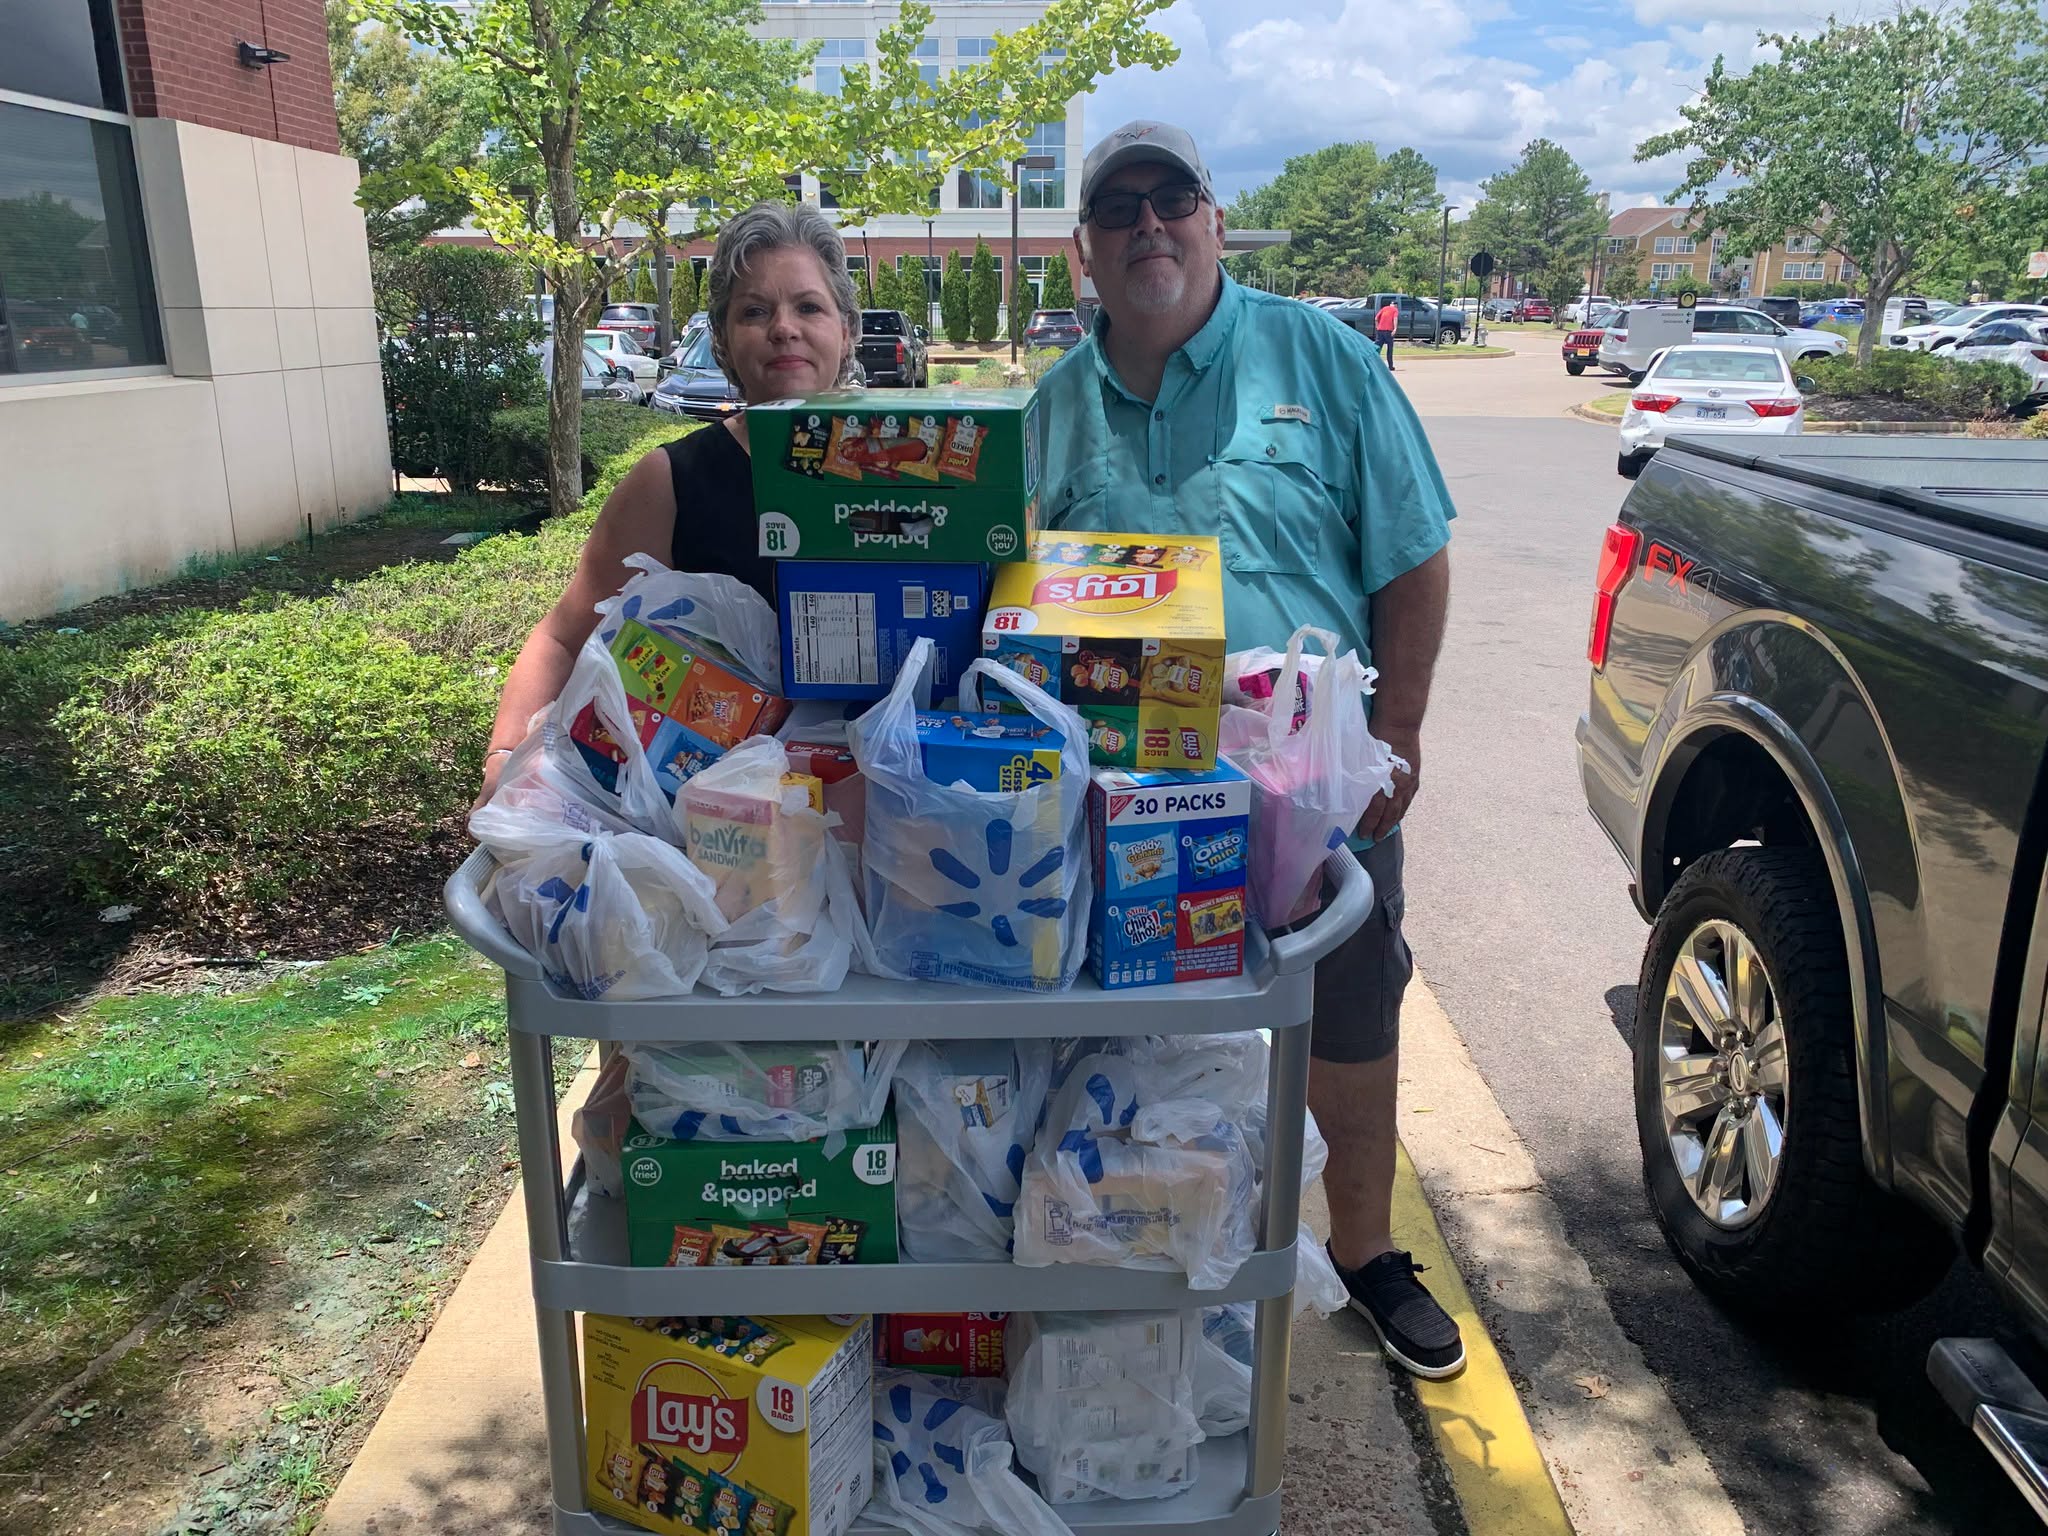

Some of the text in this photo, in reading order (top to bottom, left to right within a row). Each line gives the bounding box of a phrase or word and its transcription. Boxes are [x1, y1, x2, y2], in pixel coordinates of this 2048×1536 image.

[766, 530, 786, 551] 18
[991, 532, 1013, 542] fried
[994, 542, 1011, 551] not
[1643, 540, 1720, 613] FX4
[1048, 572, 1158, 604] Lay's
[994, 616, 1020, 631] 18
[986, 638, 997, 646] 3
[1144, 727, 1171, 749] 18
[1182, 732, 1201, 757] Lay's
[1144, 749, 1169, 757] BAGS
[1002, 768, 1012, 792] SIZE
[1014, 757, 1025, 793] Class
[1134, 792, 1226, 816] 30 PACKS
[1127, 839, 1162, 855] Teddy
[1195, 836, 1241, 861] OREO
[1209, 847, 1238, 866] mini
[698, 850, 742, 868] SANDWI
[1125, 906, 1149, 918] Mini
[1124, 913, 1153, 936] Chips
[637, 1162, 654, 1171] not
[720, 1157, 798, 1180] baked
[866, 1149, 887, 1170] 18
[634, 1170, 657, 1179] fried
[866, 1169, 887, 1177] BAGS
[701, 1178, 817, 1208] & popped
[977, 1334, 989, 1368] CUPS
[771, 1385, 794, 1414] 18
[647, 1385, 737, 1453] Lay's
[771, 1410, 794, 1423] BAGS
